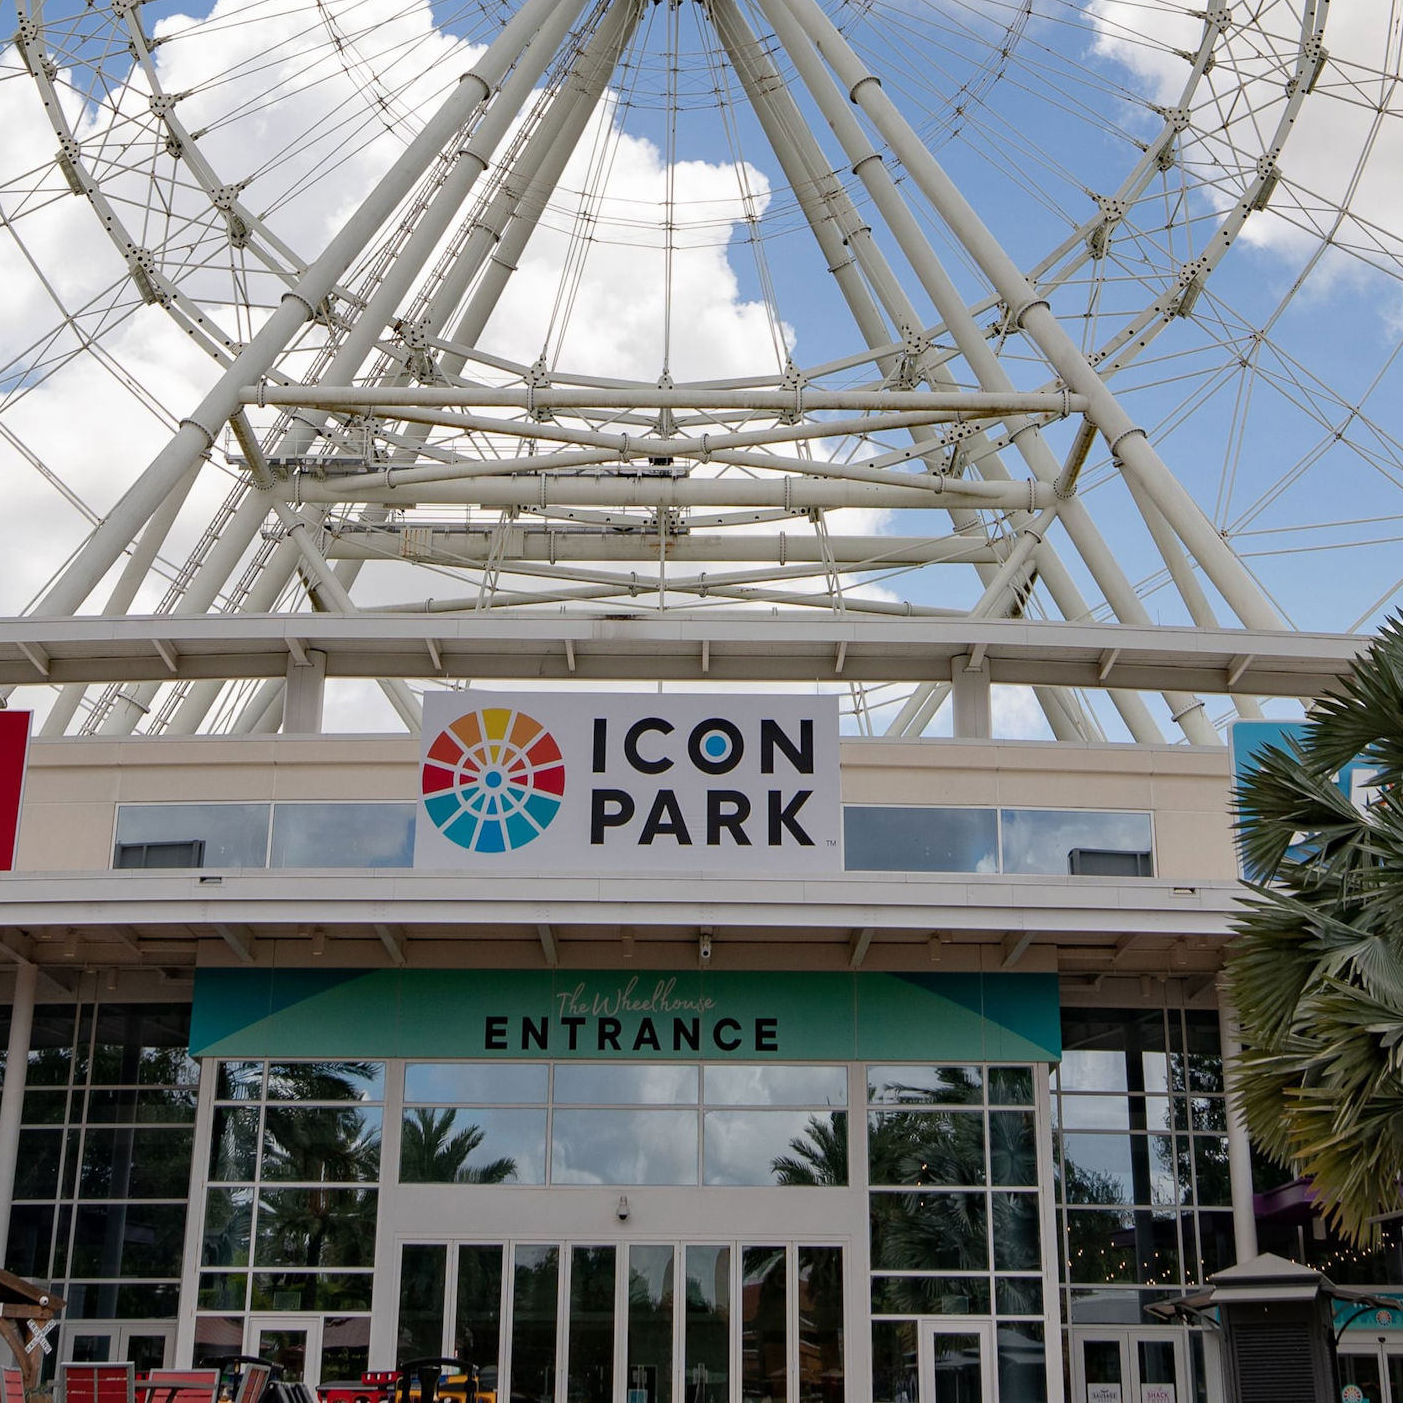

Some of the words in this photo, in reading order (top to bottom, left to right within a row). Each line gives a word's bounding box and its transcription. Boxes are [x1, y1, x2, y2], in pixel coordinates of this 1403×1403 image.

[592, 717, 814, 775] ICON
[590, 789, 816, 846] PARK
[557, 982, 591, 1018] The
[592, 976, 716, 1016] Wheelhouse
[485, 1016, 778, 1051] ENTRANCE
